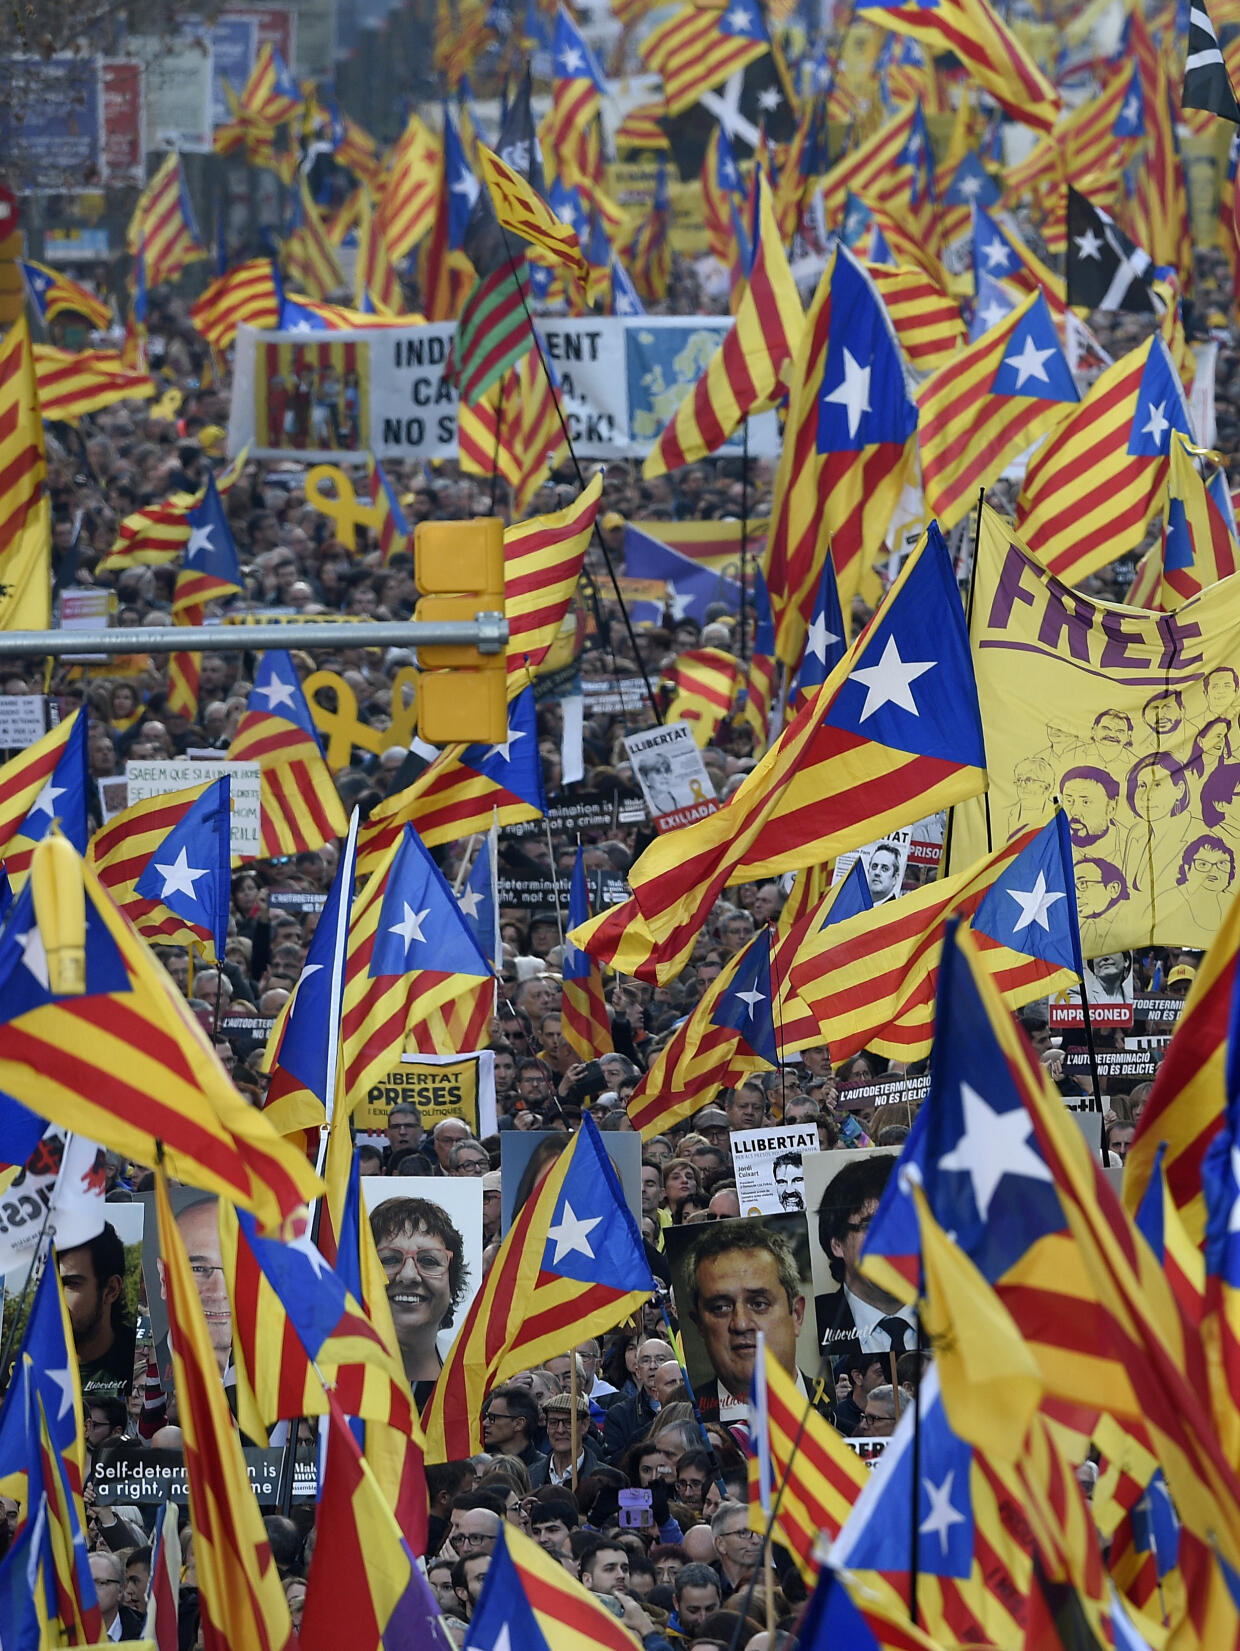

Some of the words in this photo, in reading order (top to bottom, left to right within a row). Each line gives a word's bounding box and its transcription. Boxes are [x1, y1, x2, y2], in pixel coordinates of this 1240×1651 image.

[383, 418, 426, 446] NO
[988, 543, 1203, 669] FREE
[629, 727, 688, 754] LLIBERTAT
[129, 767, 167, 781] SABEM
[169, 768, 189, 781] QUE
[660, 803, 718, 830] EXILIADA
[1053, 1008, 1130, 1021] IMPRSONED
[1148, 1011, 1160, 1020] NO
[1097, 1066, 1108, 1075] NO
[1110, 1063, 1120, 1074] ÉS
[1122, 1063, 1155, 1074] DELICTE
[368, 1086, 462, 1106] PRESES
[841, 1074, 931, 1102] L'AUTODETERMINACIÓ
[874, 1096, 887, 1107] NO
[889, 1093, 900, 1104] ÉS
[902, 1087, 931, 1102] DELICT
[734, 1133, 815, 1154] LLIBERTAT
[263, 1462, 277, 1478] is
[99, 1484, 109, 1495] a
[117, 1481, 163, 1501] right,
